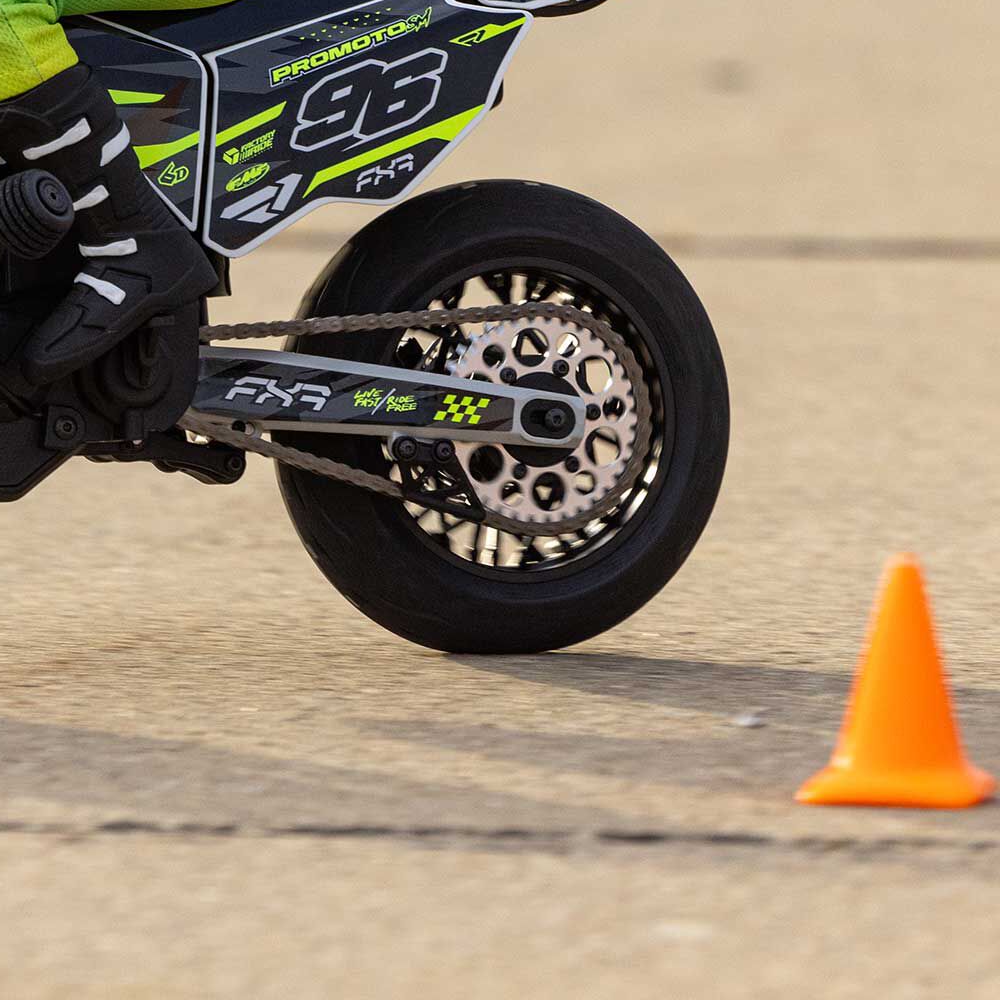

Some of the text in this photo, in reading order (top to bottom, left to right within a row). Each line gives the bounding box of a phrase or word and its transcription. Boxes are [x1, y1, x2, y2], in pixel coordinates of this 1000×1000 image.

[269, 19, 408, 88] PROMOTO
[290, 47, 449, 152] 96
[157, 160, 190, 187] 6D
[355, 153, 415, 193] FXR
[225, 375, 332, 412] FXR
[353, 388, 384, 399] LIVE
[386, 395, 415, 406] RIDE
